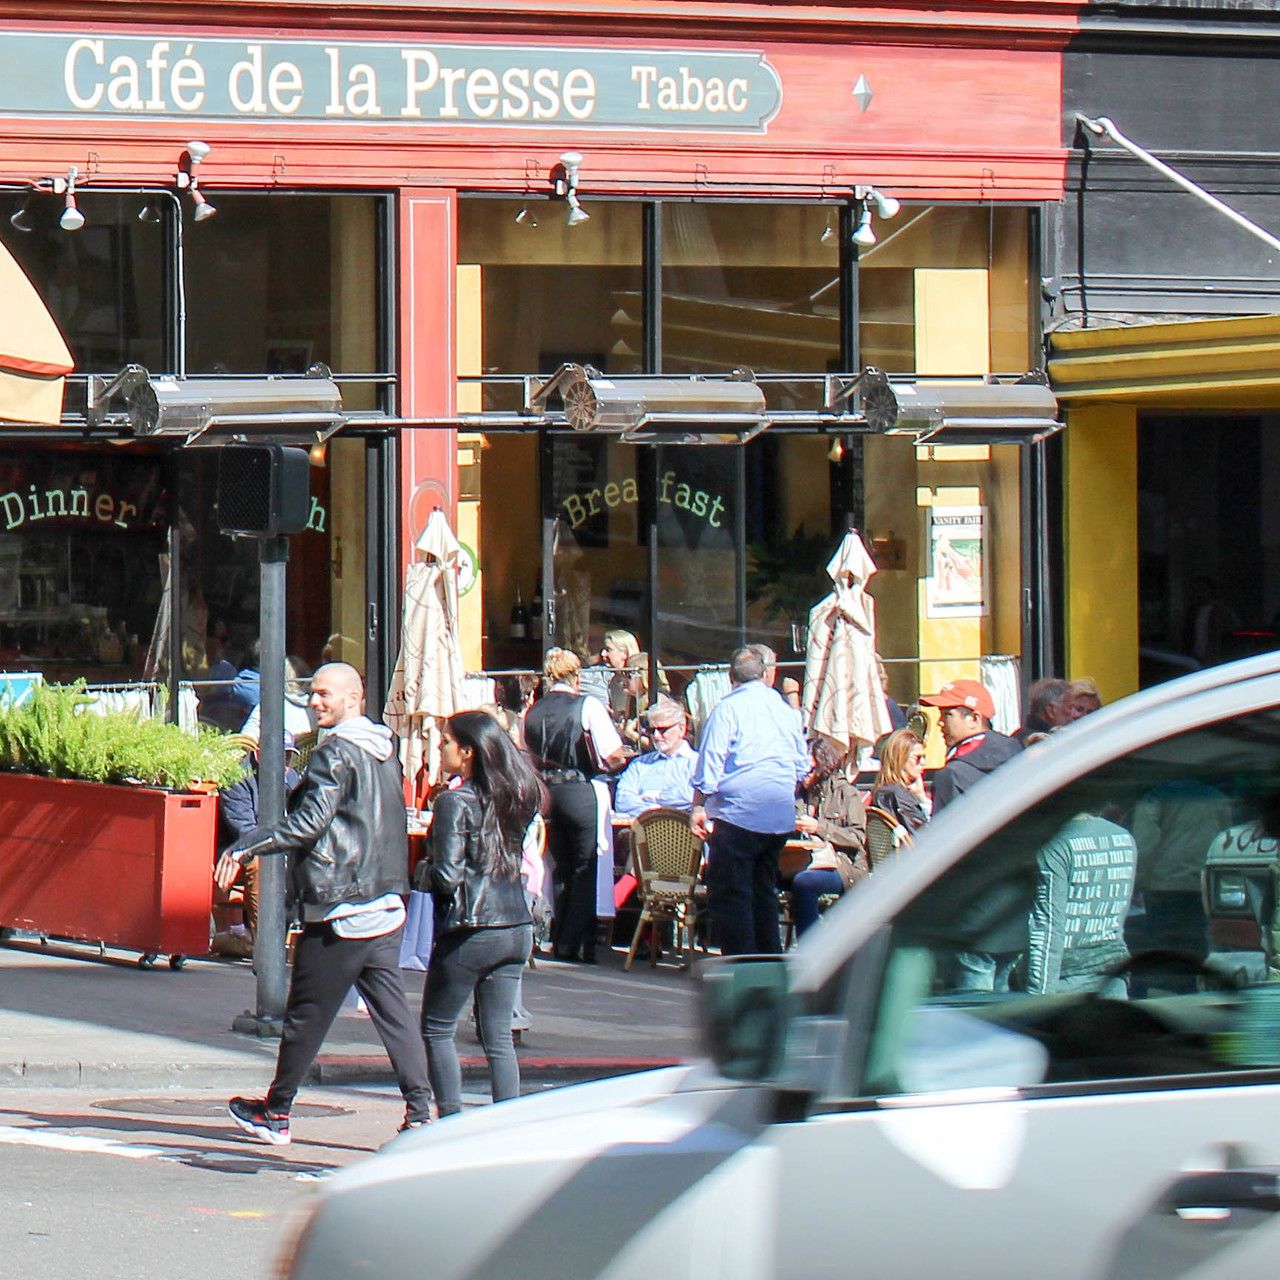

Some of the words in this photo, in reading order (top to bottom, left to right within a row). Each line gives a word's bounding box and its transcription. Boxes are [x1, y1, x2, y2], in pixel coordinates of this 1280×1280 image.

[63, 38, 207, 111] Café
[227, 44, 305, 114] de
[323, 46, 382, 116] la
[400, 48, 596, 119] Presse
[631, 64, 749, 113] Tabac
[562, 471, 726, 531] Breafast
[933, 516, 961, 525] VANITY
